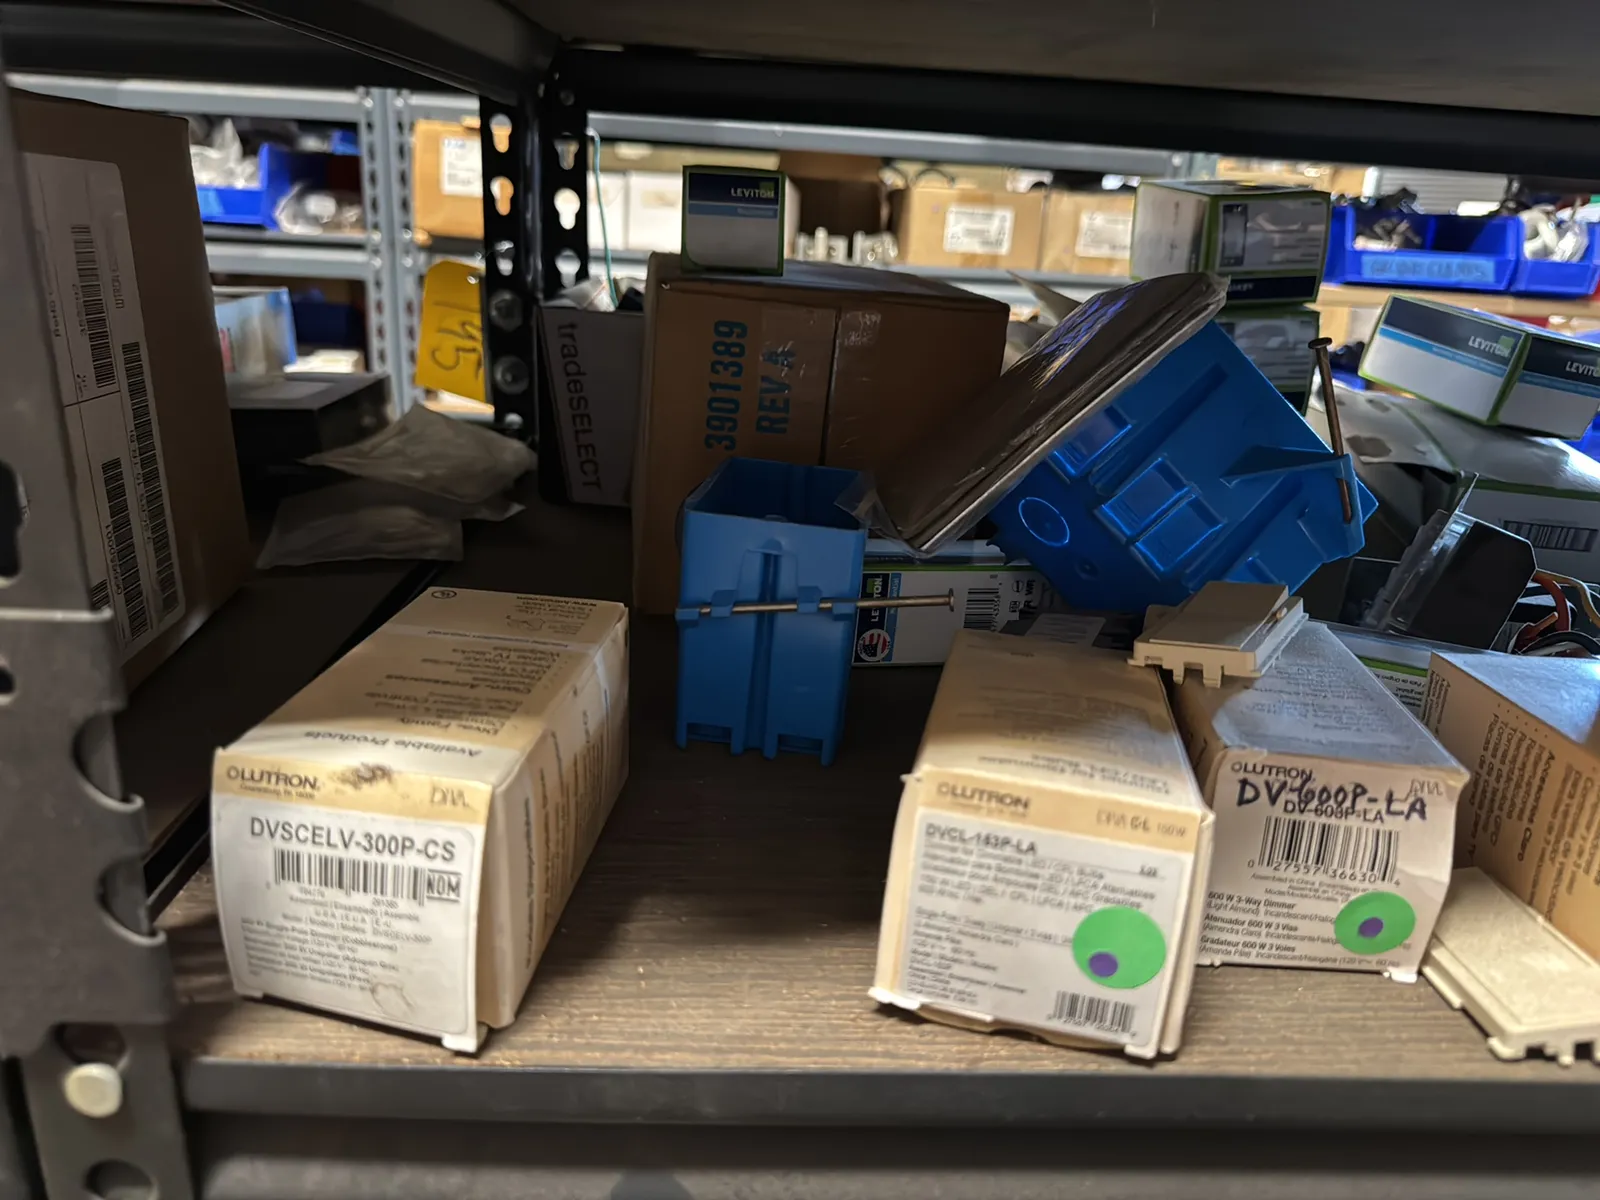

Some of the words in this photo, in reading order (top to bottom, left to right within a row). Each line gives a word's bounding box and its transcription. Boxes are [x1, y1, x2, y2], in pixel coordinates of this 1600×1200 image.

[731, 188, 775, 198] LEVITON
[760, 348, 797, 370] A
[1468, 335, 1513, 358] LEVITON
[705, 320, 748, 451] 3901389
[558, 321, 600, 492] tradeSELECT
[756, 376, 793, 434] REV
[869, 575, 883, 622] LETON
[304, 730, 389, 747] Products
[1482, 712, 1500, 752] Placas
[1490, 719, 1510, 760] Tomas
[394, 739, 483, 758] Available
[1499, 726, 1519, 766] Tomas
[1241, 763, 1313, 780] LUTRON
[1527, 750, 1556, 825] Accesorios
[250, 817, 457, 861] DVSCELV-300P-CS
[1517, 826, 1533, 862] Claro
[1273, 860, 1321, 877] 27557
[1328, 868, 1378, 885] 36630
[427, 875, 461, 898] NOM
[1236, 895, 1262, 908] 3-Way
[1263, 899, 1297, 911] Dimmer
[1204, 913, 1247, 927] Atenuador
[1247, 919, 1264, 928] 600
[1200, 936, 1241, 948] Gradateur
[1241, 940, 1258, 950] 600
